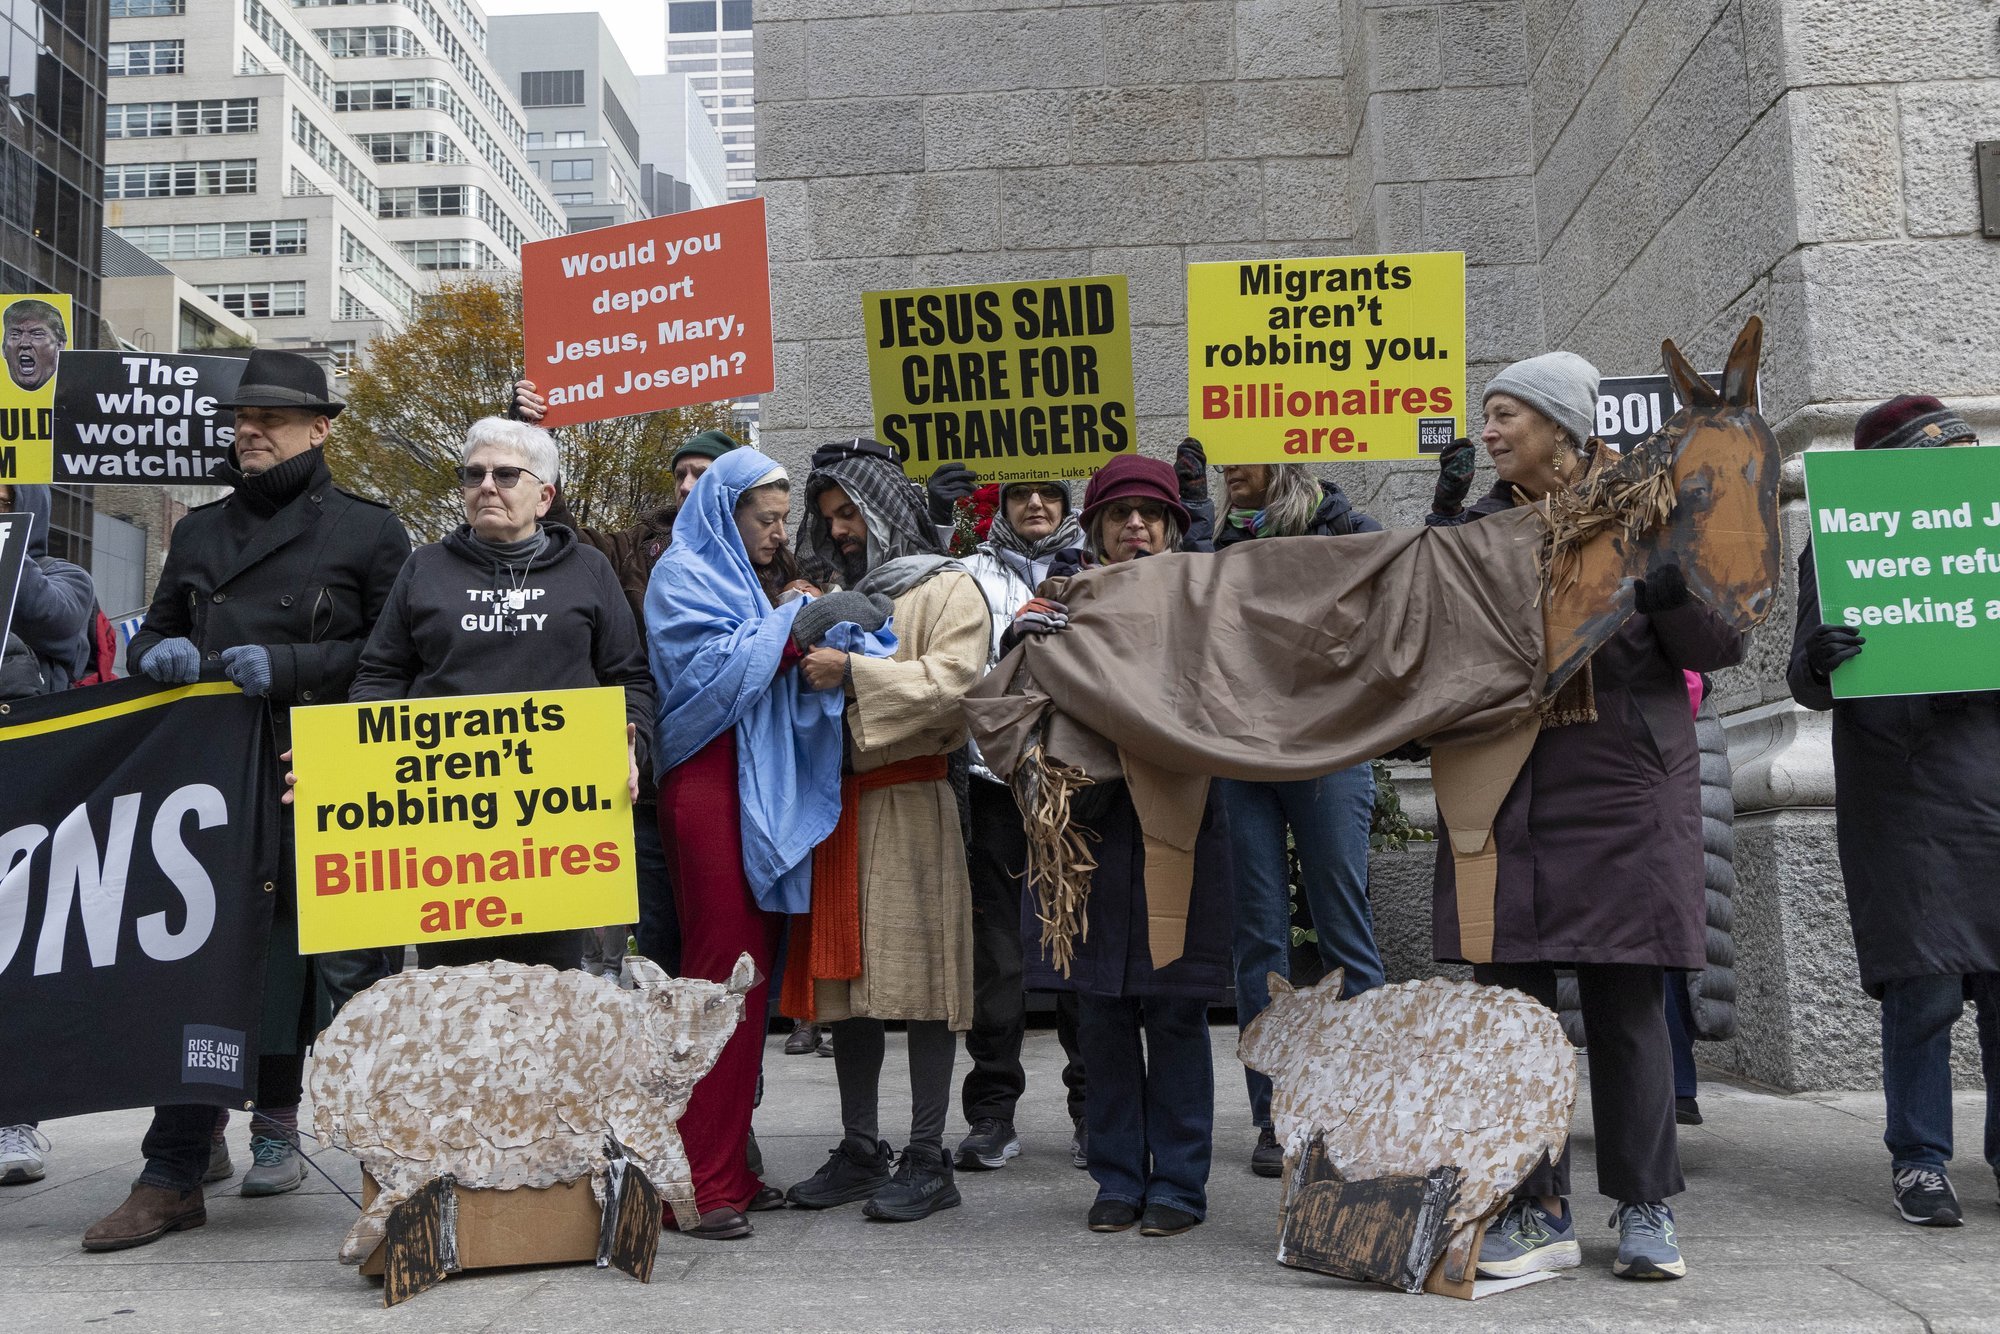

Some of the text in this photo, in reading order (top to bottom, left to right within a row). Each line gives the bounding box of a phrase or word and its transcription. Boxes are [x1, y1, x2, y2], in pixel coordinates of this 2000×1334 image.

[561, 233, 721, 278] Would you
[592, 276, 694, 314] deport
[1240, 259, 1412, 302] Migrants
[879, 284, 1115, 349] JESUS SAID
[1268, 295, 1382, 329] aren’t
[547, 315, 745, 364] Jesus, Mary,
[1205, 334, 1448, 372] robbing you.
[122, 357, 198, 386] The
[548, 352, 747, 406] and Joseph?
[902, 345, 1099, 405] CARE FOR
[96, 387, 218, 416] whole
[1203, 380, 1453, 420] Billionaires
[76, 418, 236, 447] world is
[882, 401, 1129, 463] STRANGERS
[1283, 427, 1368, 455] are.
[1421, 426, 1452, 435] RISE AND
[1421, 434, 1452, 445] RESIST
[62, 449, 225, 478] watchin
[976, 471, 995, 482] ood
[999, 469, 1050, 481] Samaritan
[1061, 467, 1085, 478] Luke
[1819, 508, 1900, 538] Mary
[1911, 502, 1973, 530] and
[1846, 556, 1931, 579] were
[1843, 597, 1977, 628] seeking
[357, 697, 566, 750] Migrants
[394, 739, 533, 784] aren’t
[316, 784, 612, 832] robbing you.
[314, 837, 621, 897] Billionaires
[419, 895, 524, 934] are.
[187, 1051, 239, 1073] RESIST
[188, 1039, 240, 1057] RISE AND
